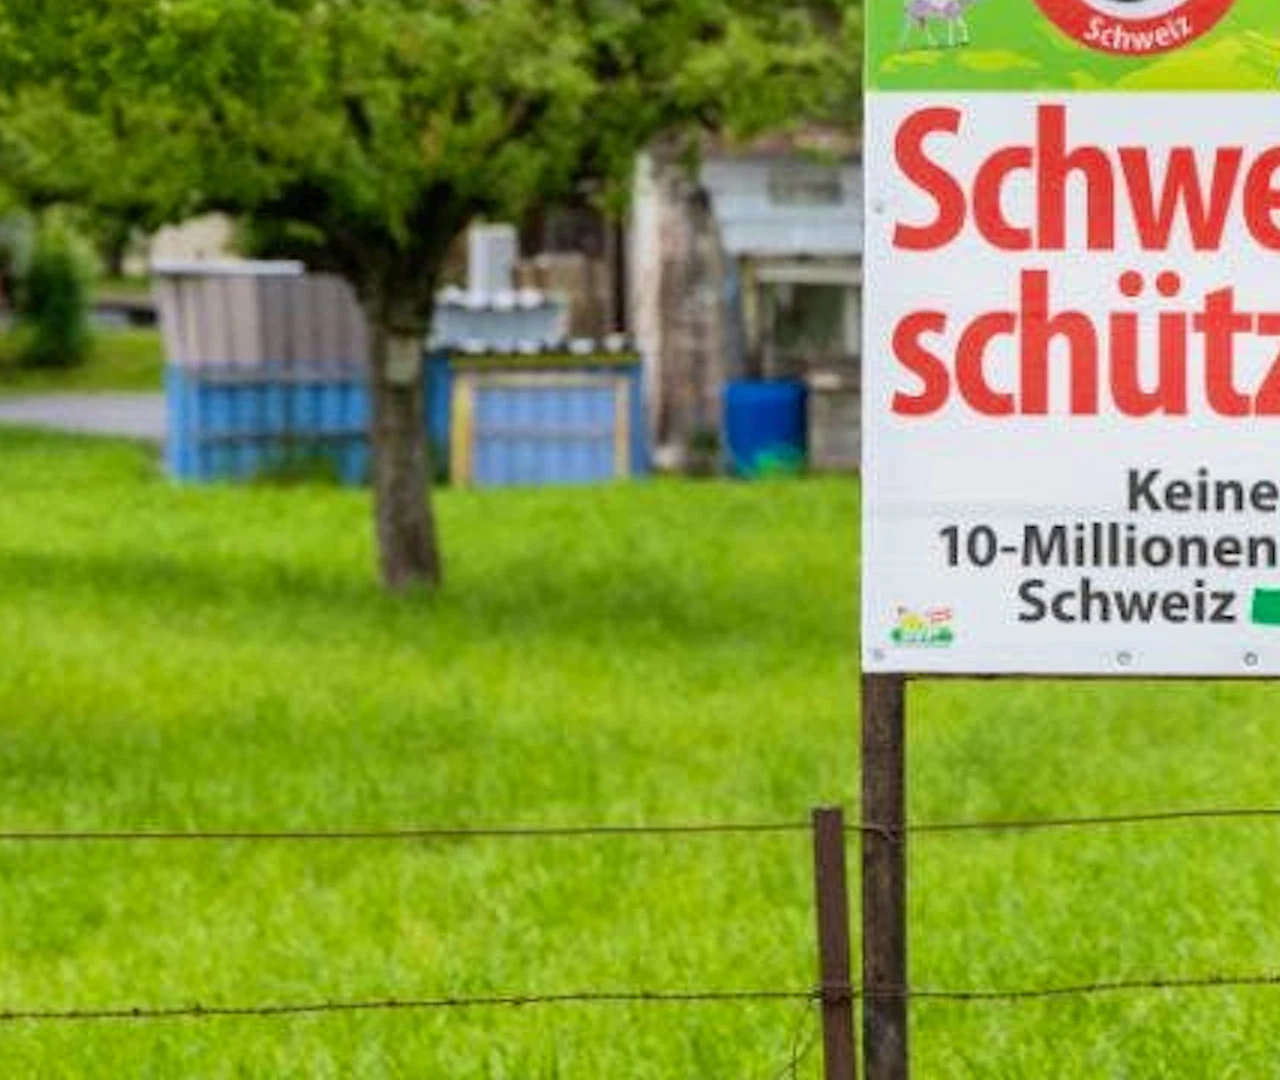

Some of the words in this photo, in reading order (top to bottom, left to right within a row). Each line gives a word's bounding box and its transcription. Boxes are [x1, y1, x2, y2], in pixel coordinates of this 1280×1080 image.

[1082, 15, 1194, 51] Schweiz
[1128, 467, 1280, 513] Keine
[939, 522, 1278, 569] 10-Millionen
[1018, 576, 1237, 624] Schweiz
